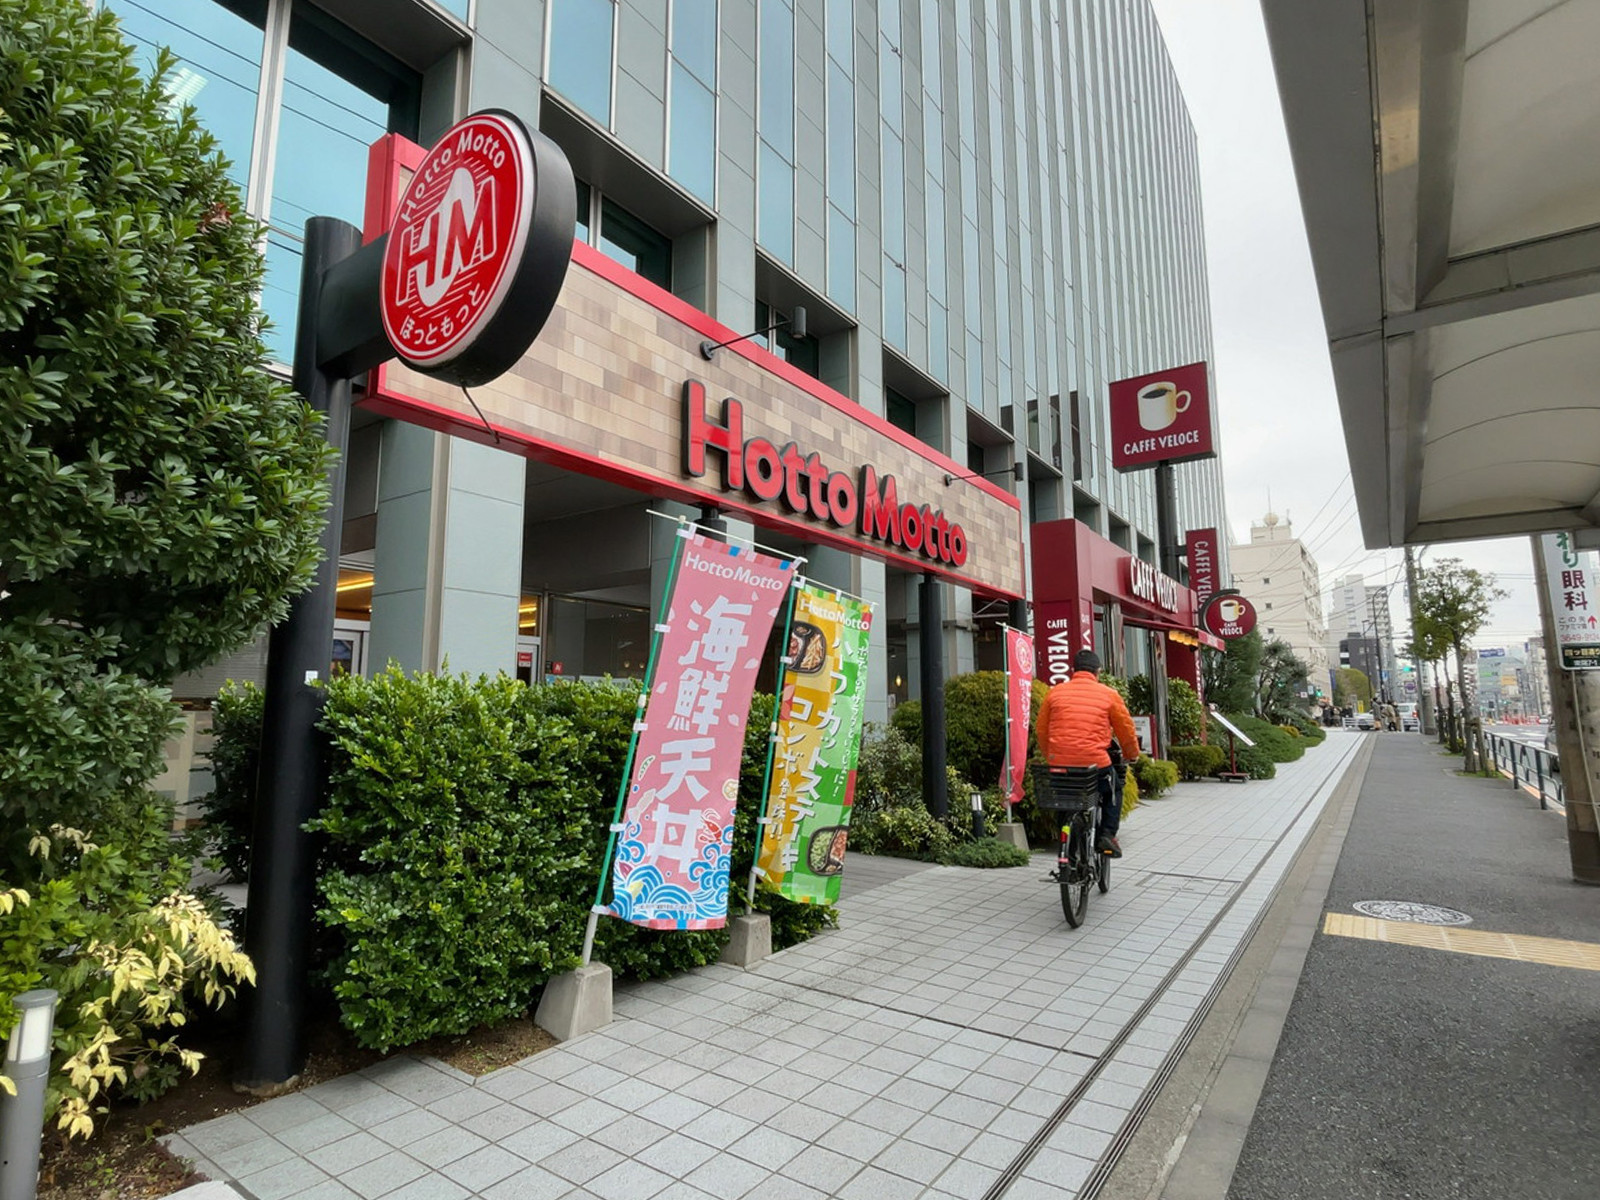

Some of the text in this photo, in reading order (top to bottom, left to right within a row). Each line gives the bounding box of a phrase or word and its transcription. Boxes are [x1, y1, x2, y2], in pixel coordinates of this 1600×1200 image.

[401, 128, 506, 223] Hotto Motto
[400, 283, 485, 345] ほっともっと
[1158, 429, 1200, 449] VELOCE
[682, 379, 968, 568] Hotto Motto
[1154, 568, 1179, 614] VELOCE
[1047, 630, 1070, 688] VELOC
[1219, 627, 1243, 635] VELOCE
[648, 595, 752, 874] 海鮮天丼
